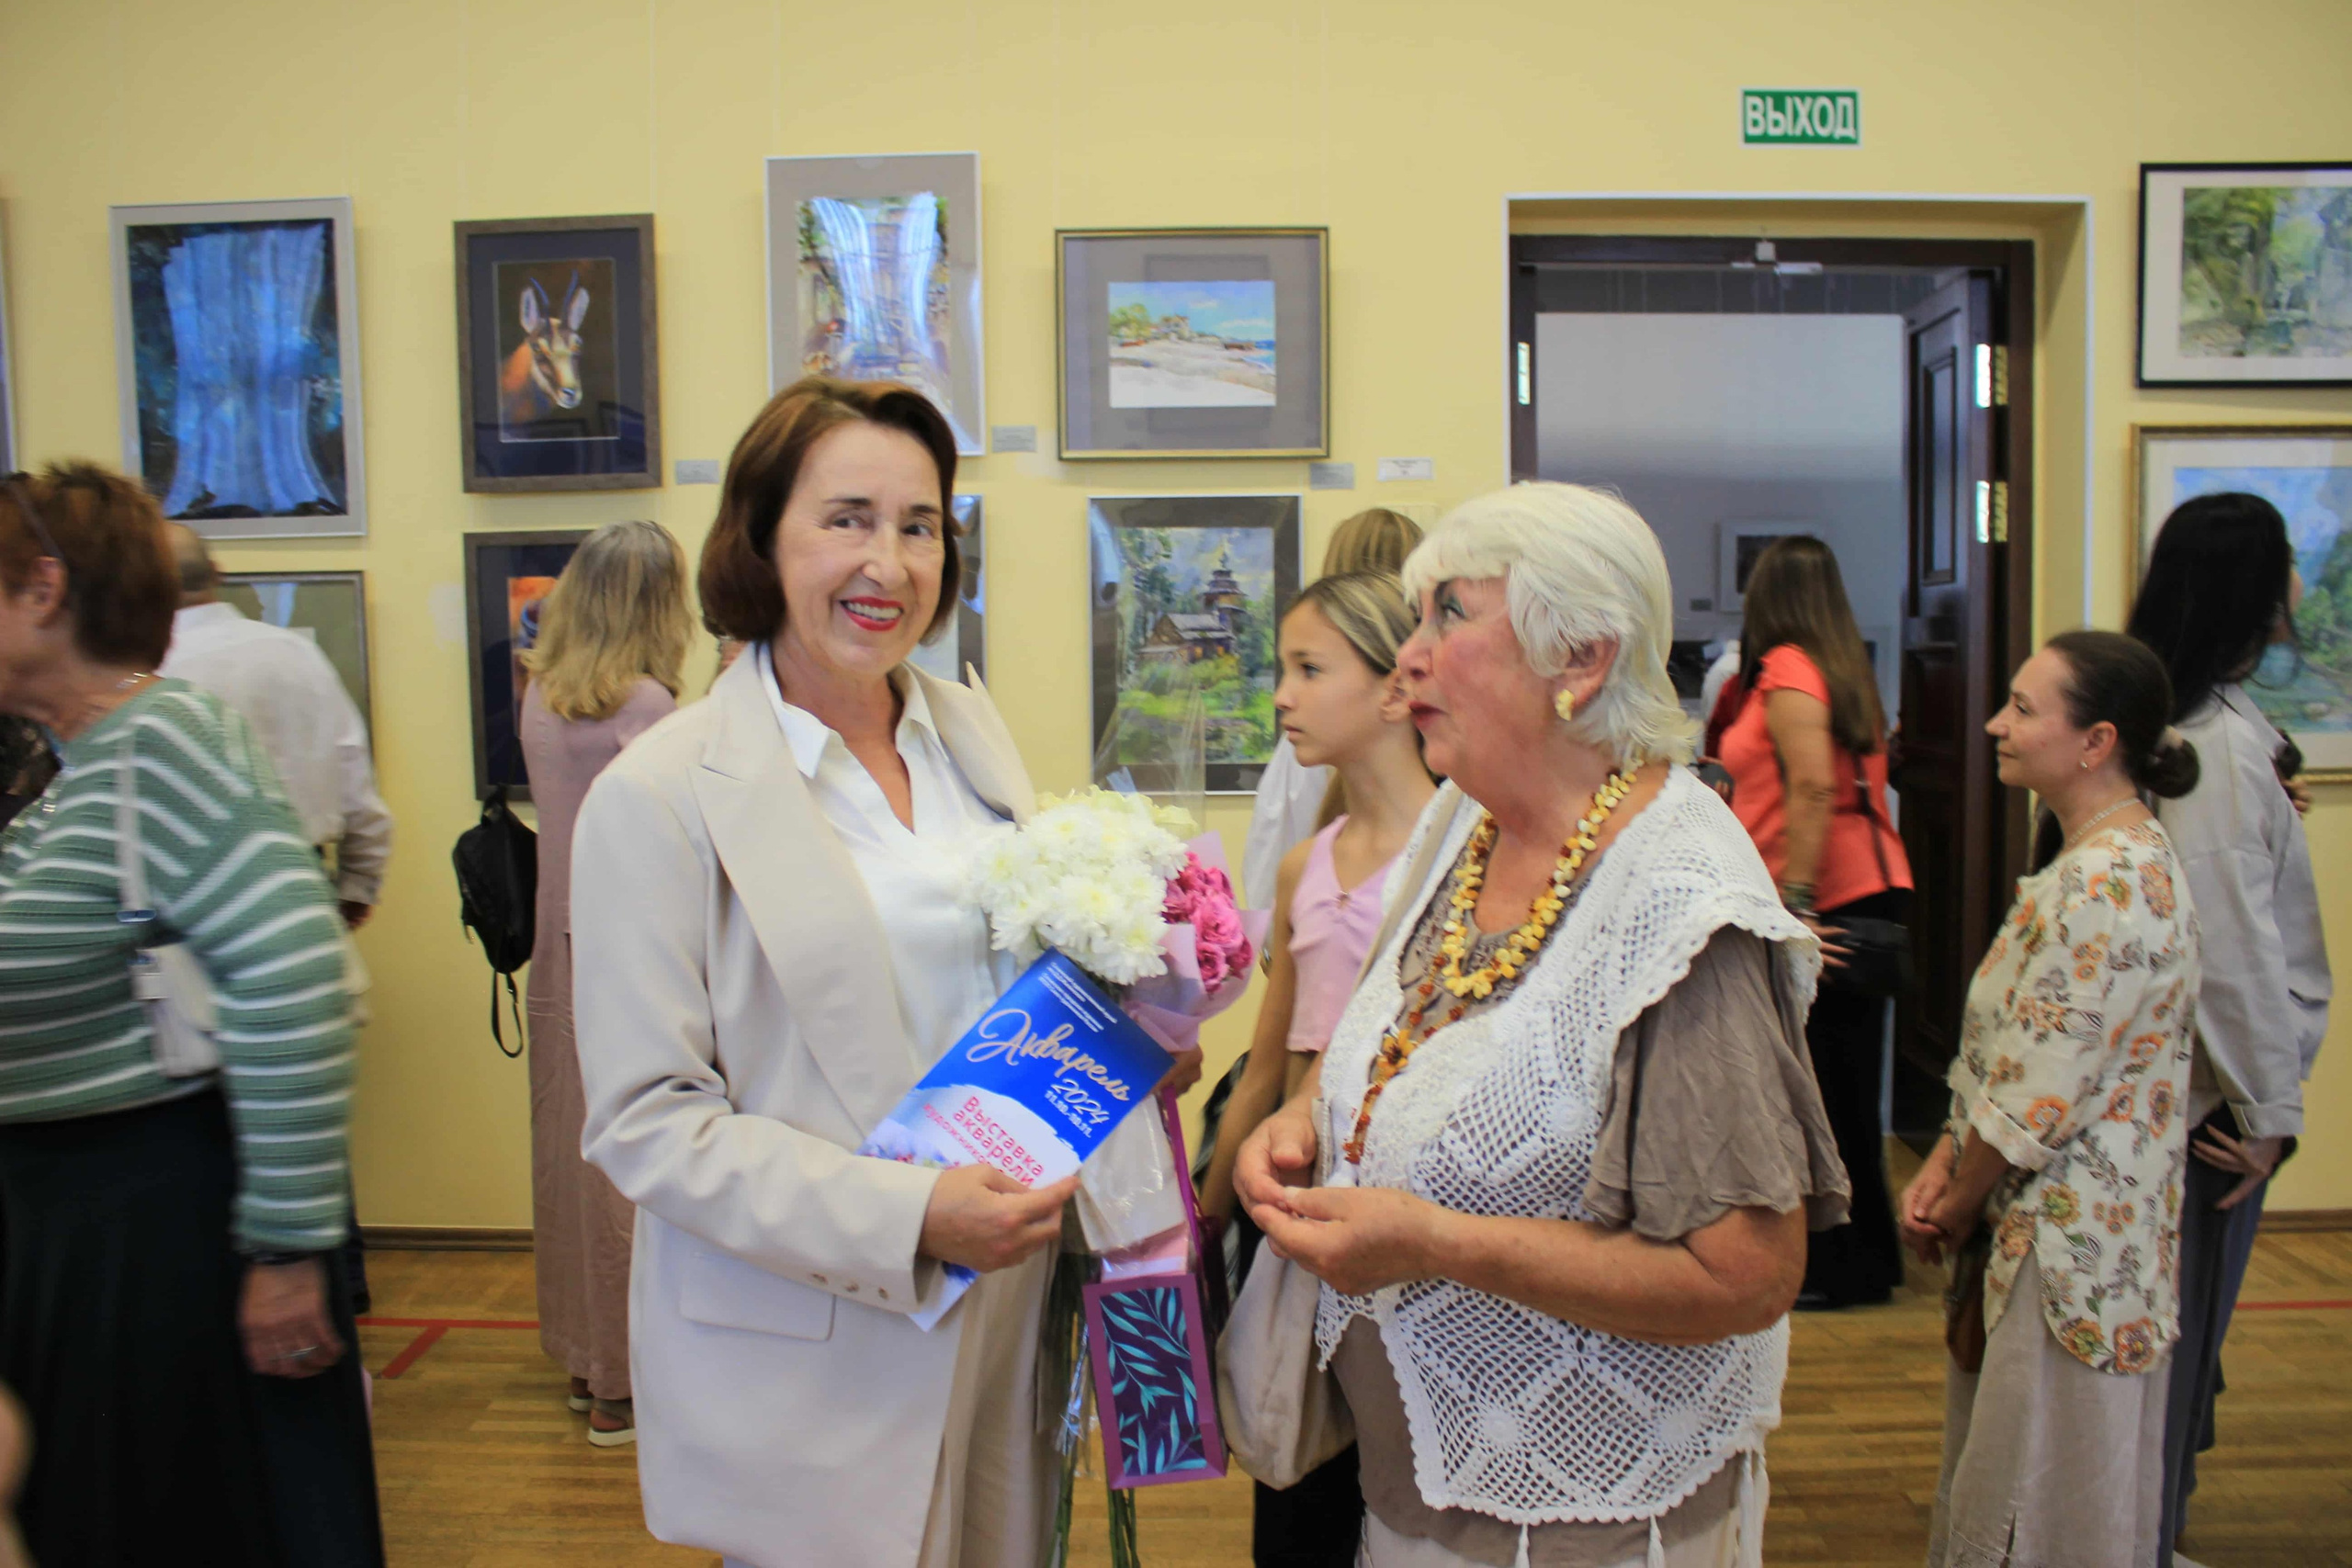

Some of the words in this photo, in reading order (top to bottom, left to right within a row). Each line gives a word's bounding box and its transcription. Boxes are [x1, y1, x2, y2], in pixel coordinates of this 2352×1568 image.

[1745, 96, 1857, 140] ВЫХОД
[967, 1009, 1129, 1101] Акварель
[923, 1103, 990, 1165] художнико
[1050, 1078, 1110, 1124] 2024
[953, 1110, 1034, 1186] акварели
[964, 1096, 1044, 1176] Выставка
